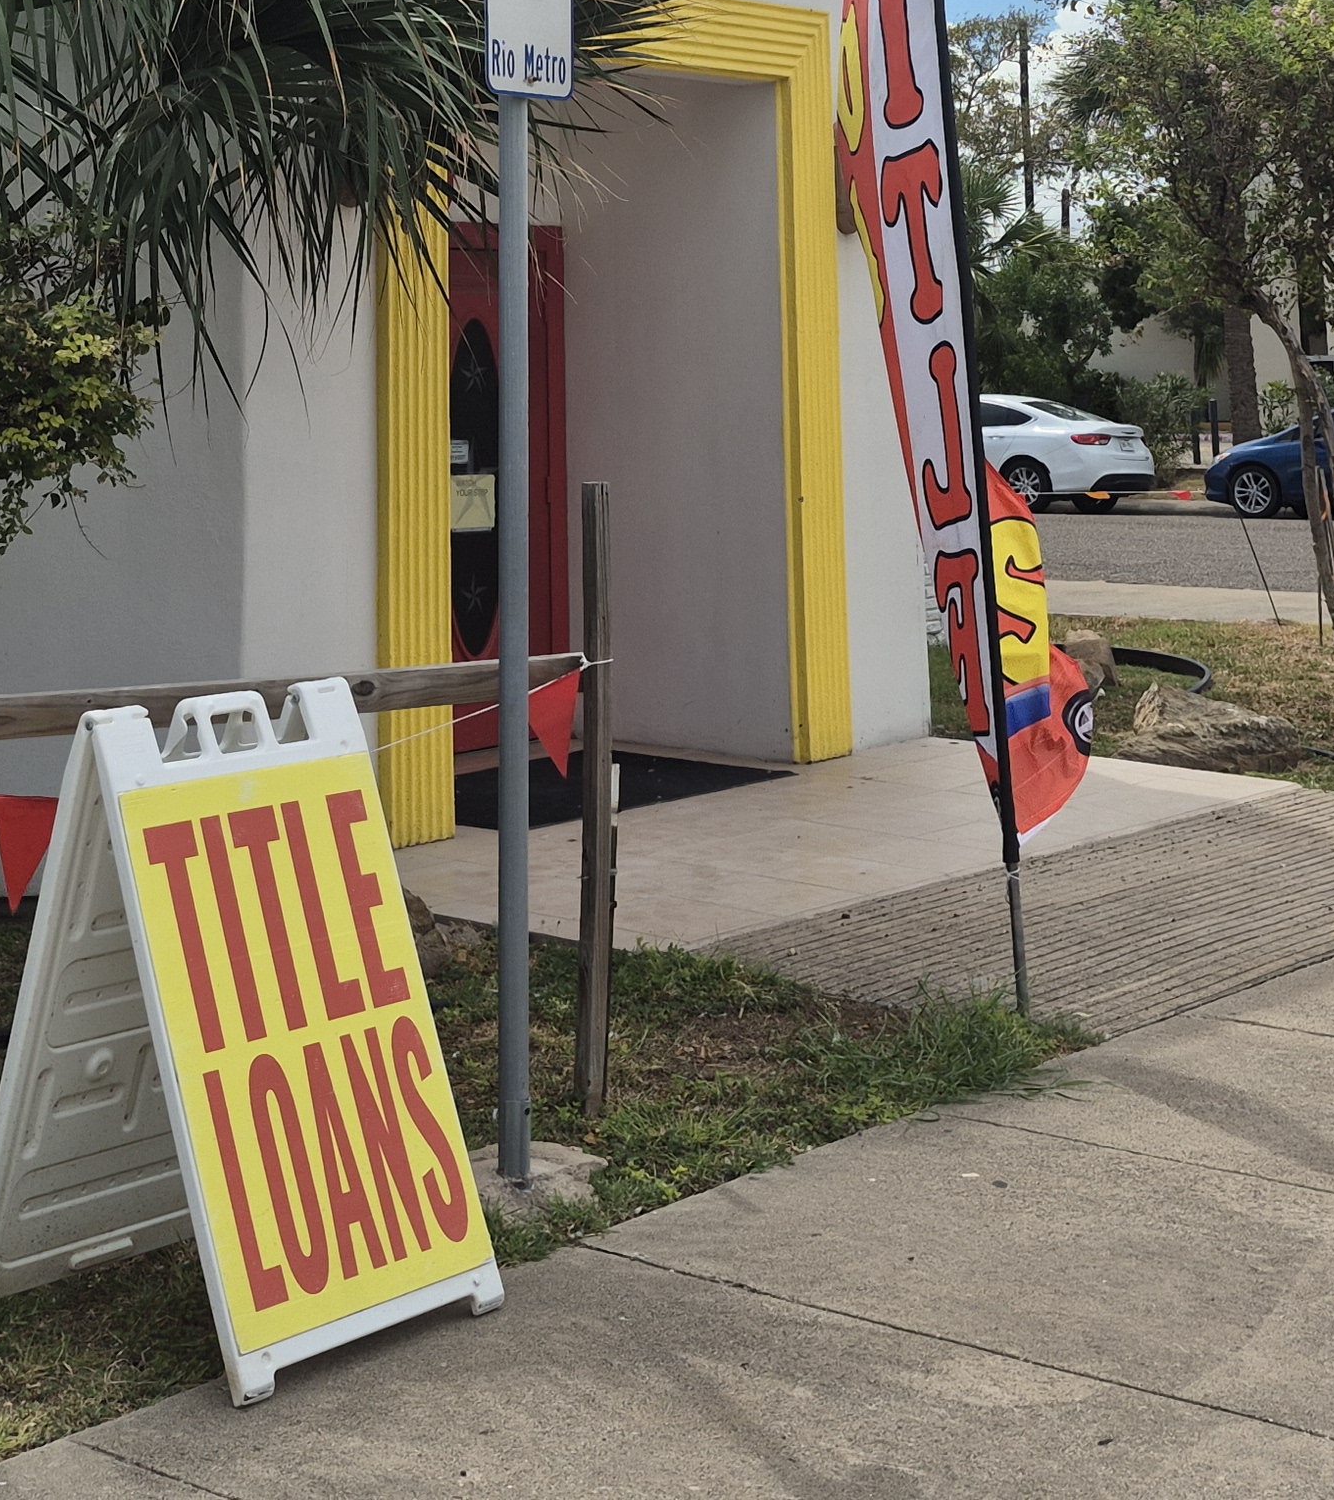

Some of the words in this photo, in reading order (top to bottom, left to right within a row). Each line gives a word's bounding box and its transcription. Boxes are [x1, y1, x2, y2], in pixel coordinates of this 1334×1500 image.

[492, 38, 515, 79] Rio
[524, 43, 566, 85] Metro
[142, 789, 411, 1054] TITLE
[202, 1015, 469, 1313] LOANS
